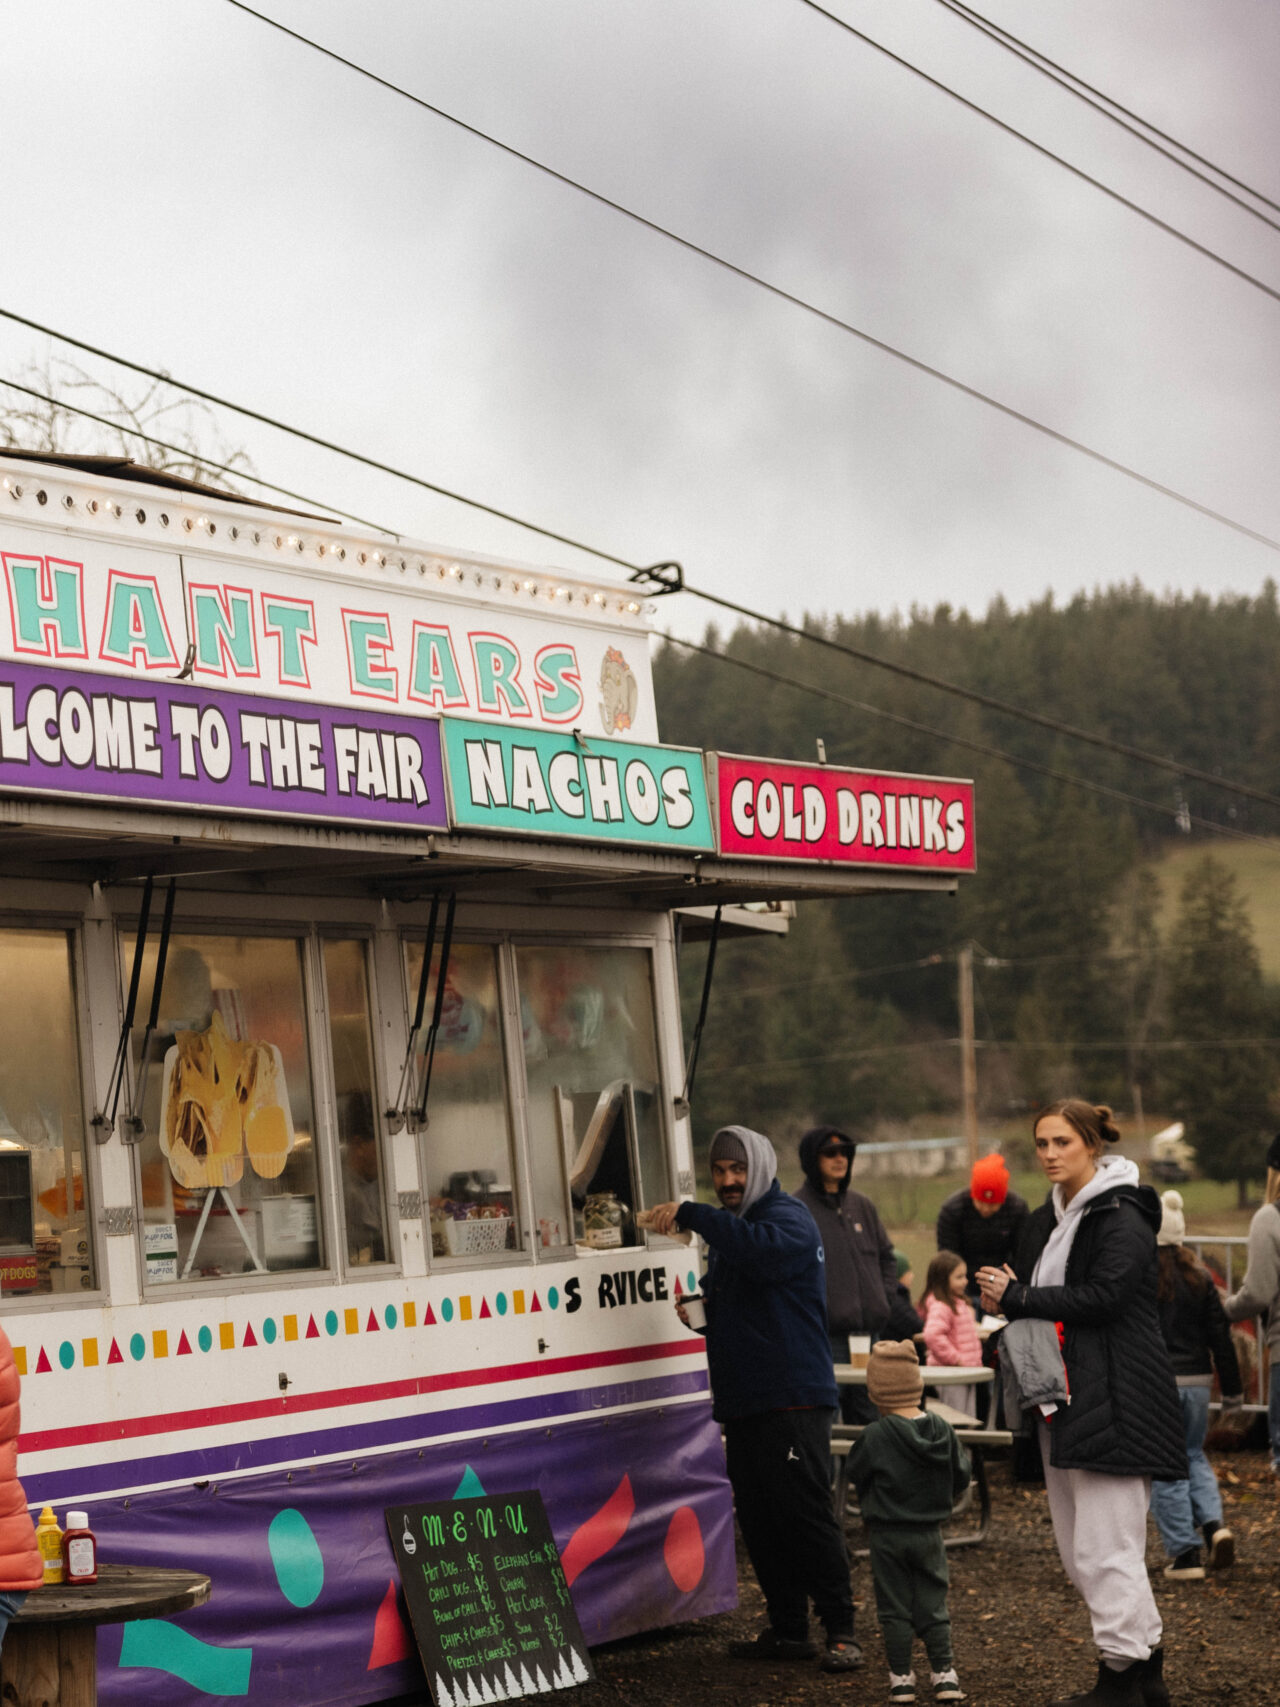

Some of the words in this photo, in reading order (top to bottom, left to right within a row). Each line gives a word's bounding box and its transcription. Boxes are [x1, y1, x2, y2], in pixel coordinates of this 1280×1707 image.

[340, 607, 584, 725] EARS
[168, 699, 232, 784] TO
[238, 709, 327, 796] THE
[331, 722, 430, 809] FAIR
[464, 738, 695, 830] NACHOS
[730, 777, 827, 843] COLD
[836, 788, 967, 855] DRINKS
[10, 1266, 36, 1280] DOGS
